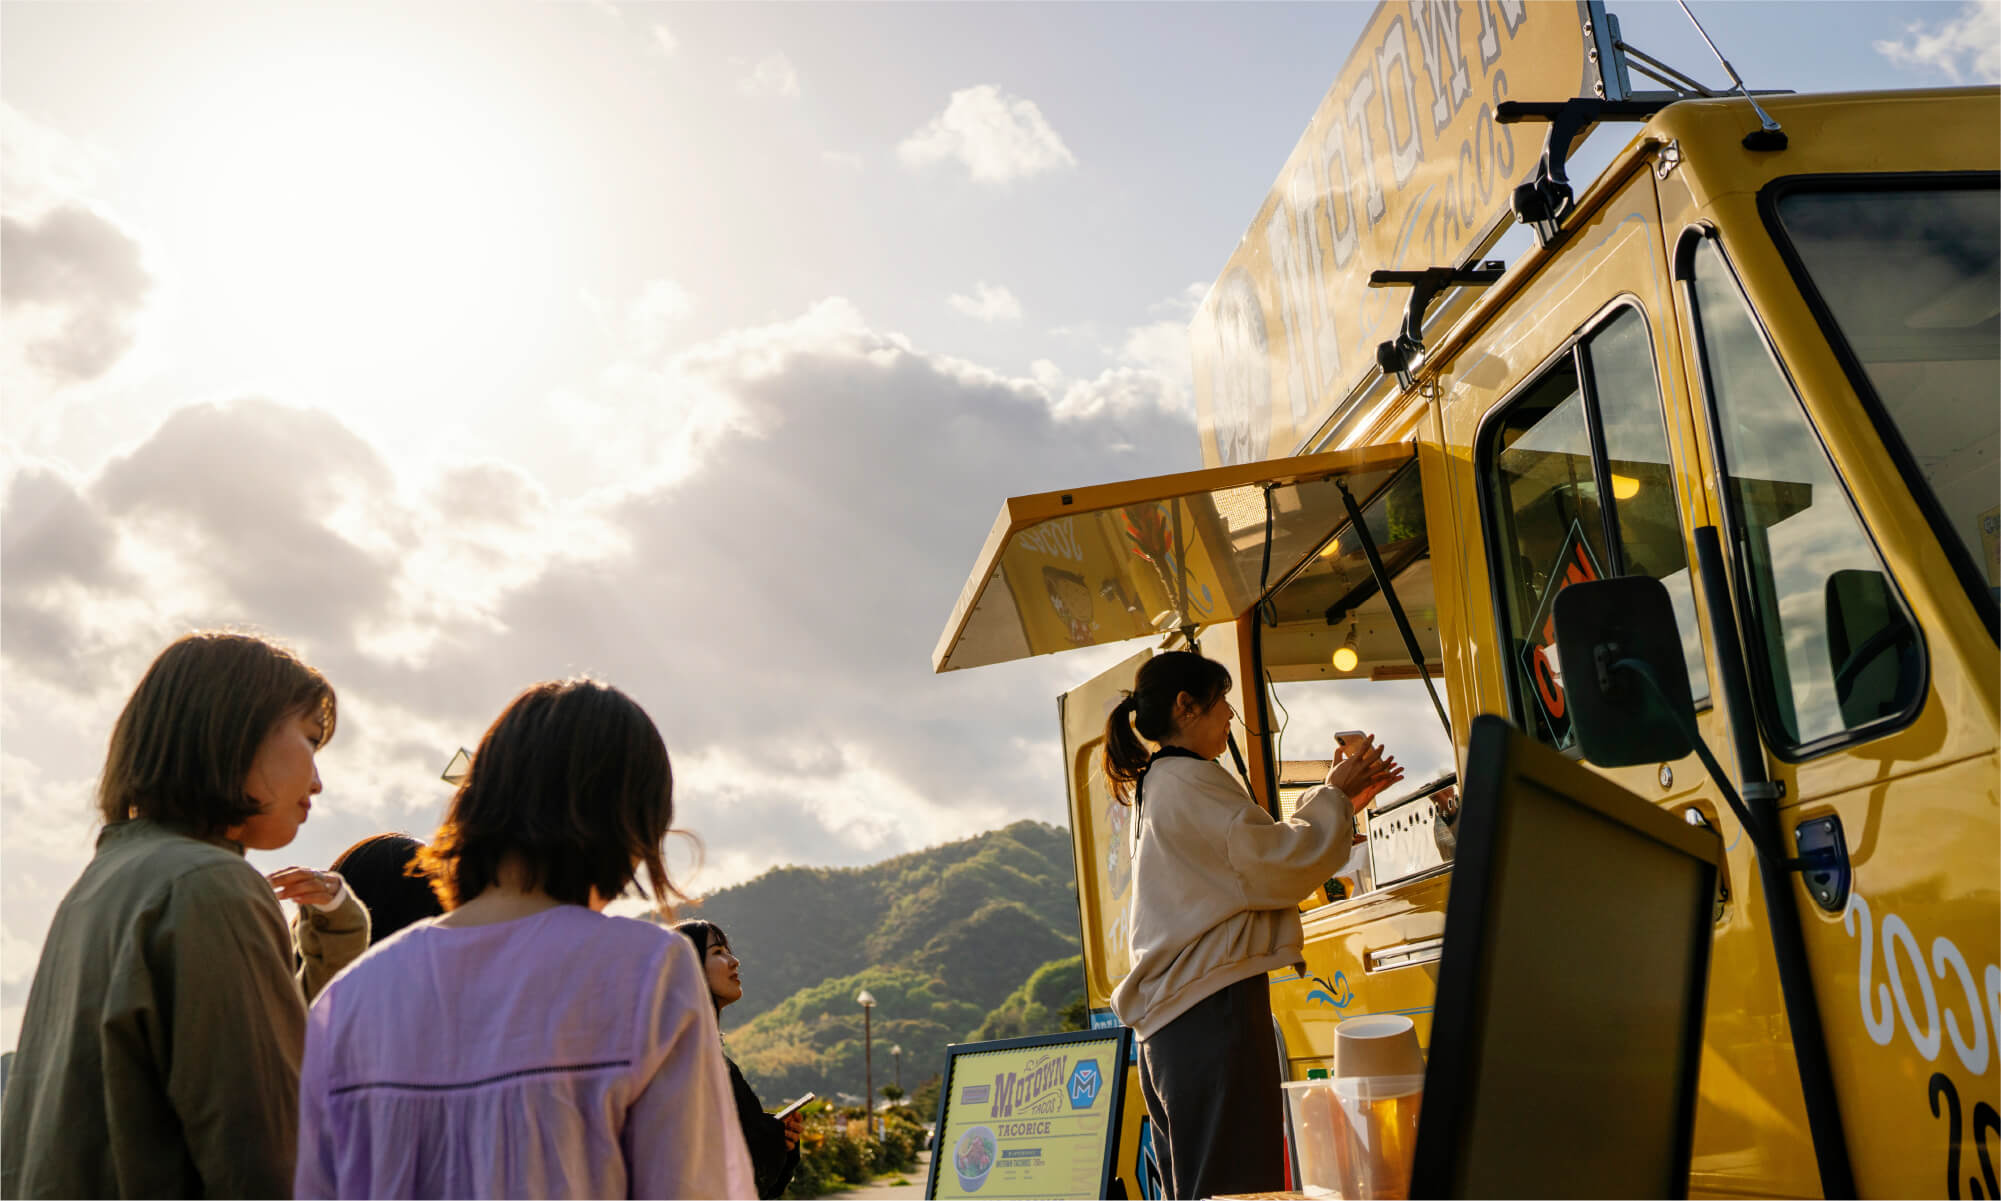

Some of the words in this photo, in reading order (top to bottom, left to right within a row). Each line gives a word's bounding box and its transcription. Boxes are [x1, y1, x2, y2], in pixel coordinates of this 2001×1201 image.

[1424, 68, 1515, 267] TACOS
[991, 1055, 1067, 1117] MOTOWN
[998, 1121, 1051, 1137] TACORICE
